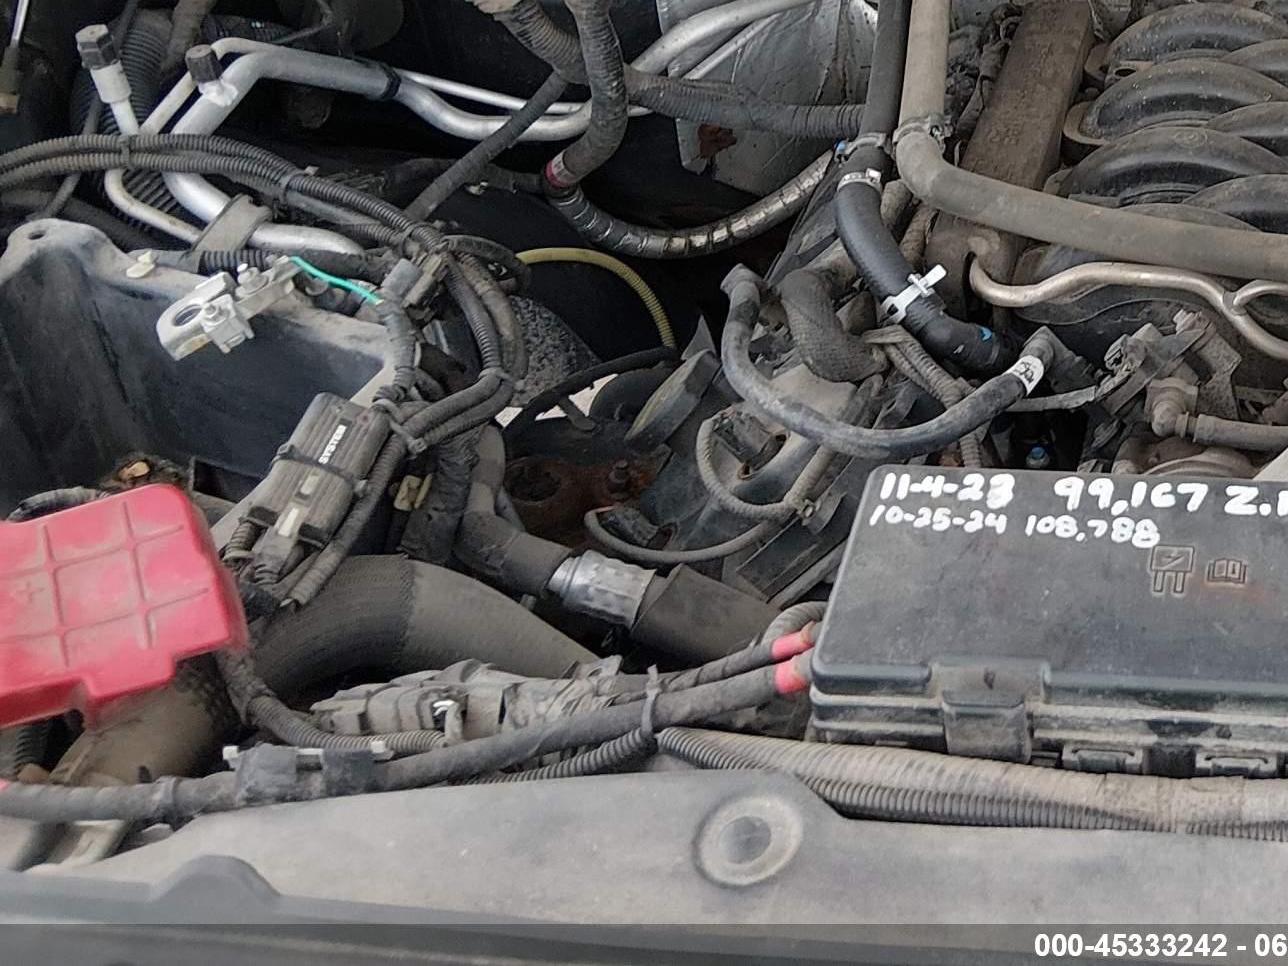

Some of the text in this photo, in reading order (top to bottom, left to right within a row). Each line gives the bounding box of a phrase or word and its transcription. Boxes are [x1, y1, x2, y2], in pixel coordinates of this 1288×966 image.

[1053, 476, 1209, 516] 99,167
[869, 504, 1161, 549] 10-25-24 108,788
